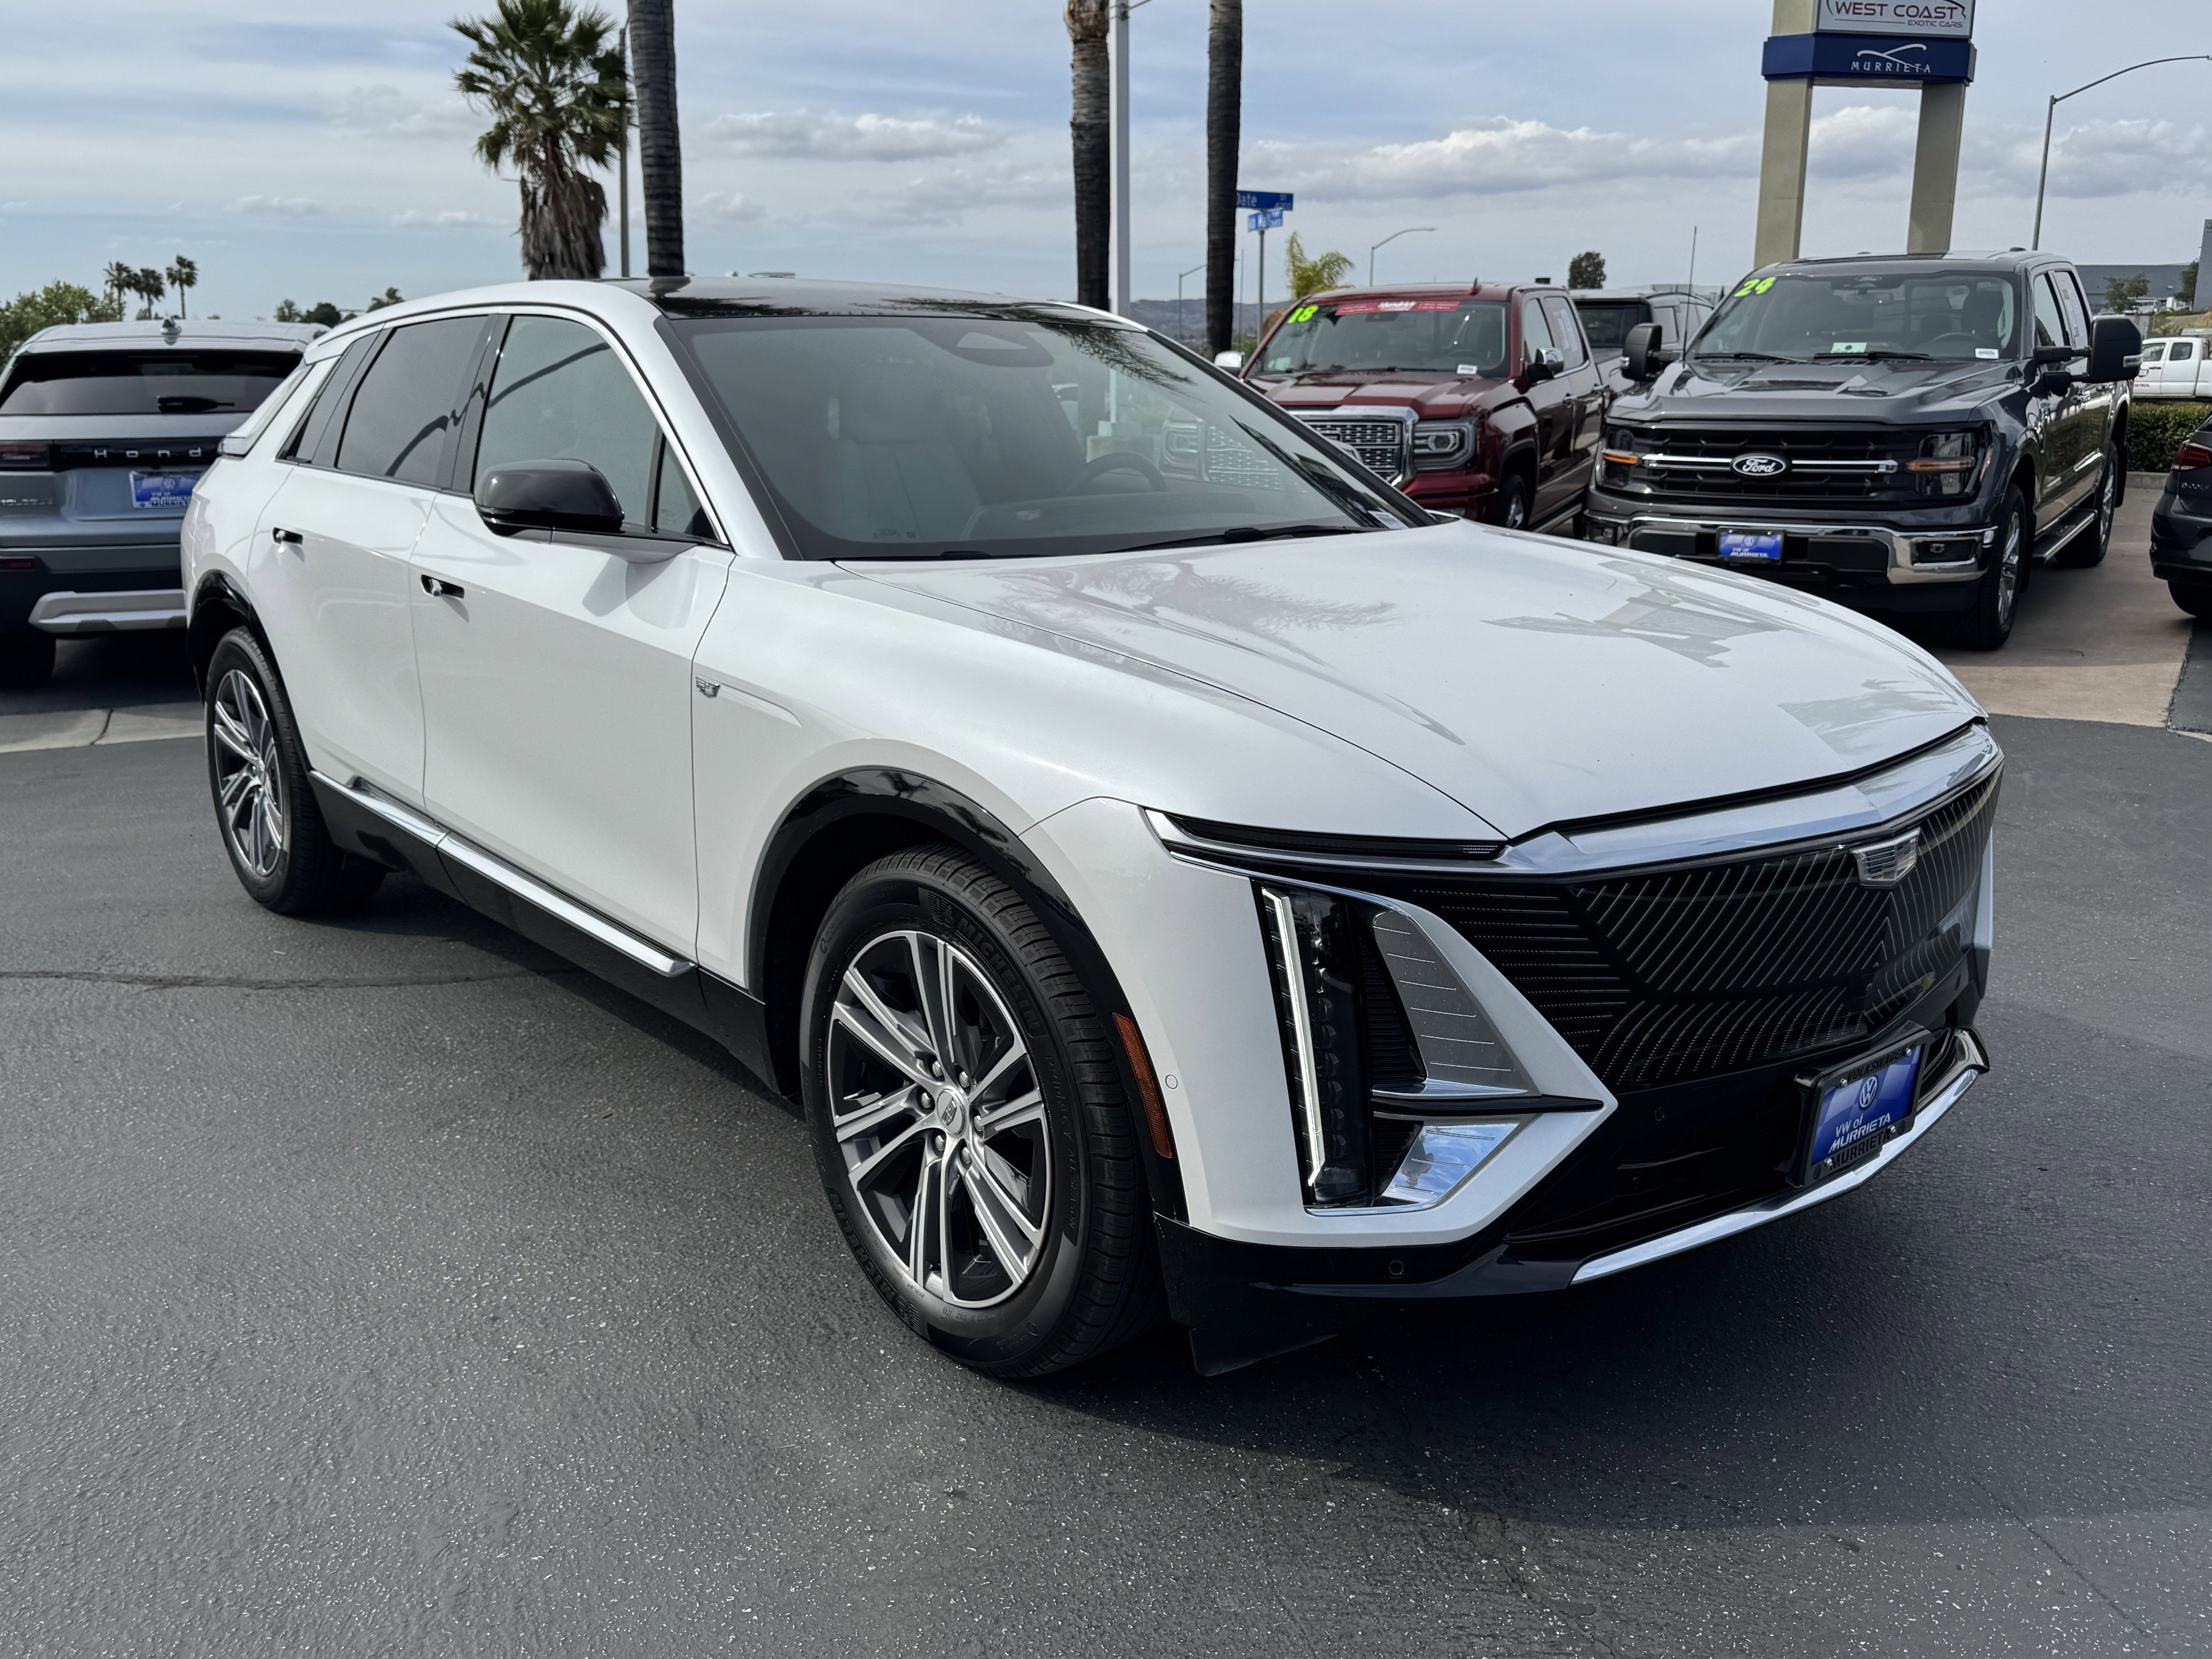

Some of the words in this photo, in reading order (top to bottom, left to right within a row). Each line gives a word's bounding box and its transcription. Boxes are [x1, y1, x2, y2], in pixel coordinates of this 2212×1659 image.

[1836, 2, 1888, 16] WEST
[1894, 5, 1958, 19] COAST
[1851, 61, 1931, 73] MURRIETA
[1734, 276, 1777, 297] 24
[1286, 305, 1319, 324] 18
[94, 447, 202, 459] Hond
[1742, 459, 1777, 472] Ford
[957, 917, 1040, 1030] MICHELIN
[1848, 1045, 1908, 1081] VOLKSWAGEN
[1044, 1055, 1074, 1142] PRIMACY
[1828, 1113, 1891, 1154] MURRIETA
[1836, 1119, 1852, 1137] VW
[1853, 1114, 1864, 1130] of
[1830, 1130, 1891, 1171] MURRIETA
[829, 1194, 896, 1302] MICHELIN
